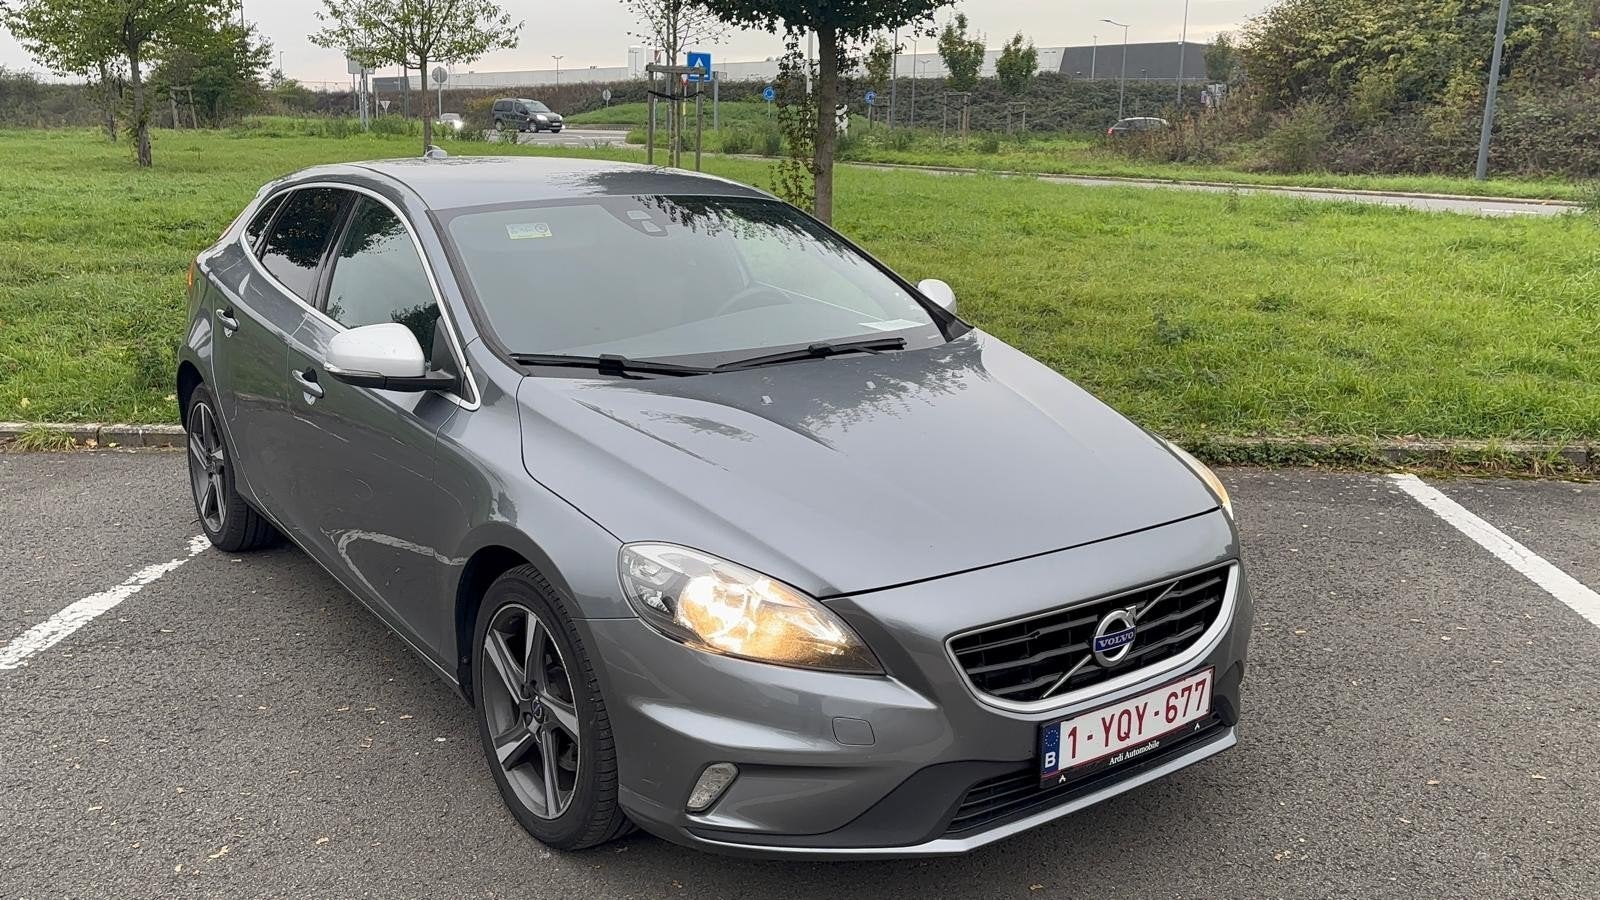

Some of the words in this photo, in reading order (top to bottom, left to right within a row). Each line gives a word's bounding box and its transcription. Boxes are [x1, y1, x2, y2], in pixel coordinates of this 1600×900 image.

[1098, 632, 1134, 648] VOLVO
[1068, 678, 1207, 759] 1-YQY-677
[1044, 751, 1056, 768] B
[1109, 753, 1124, 765] Ardi
[1124, 740, 1160, 760] Automobile
